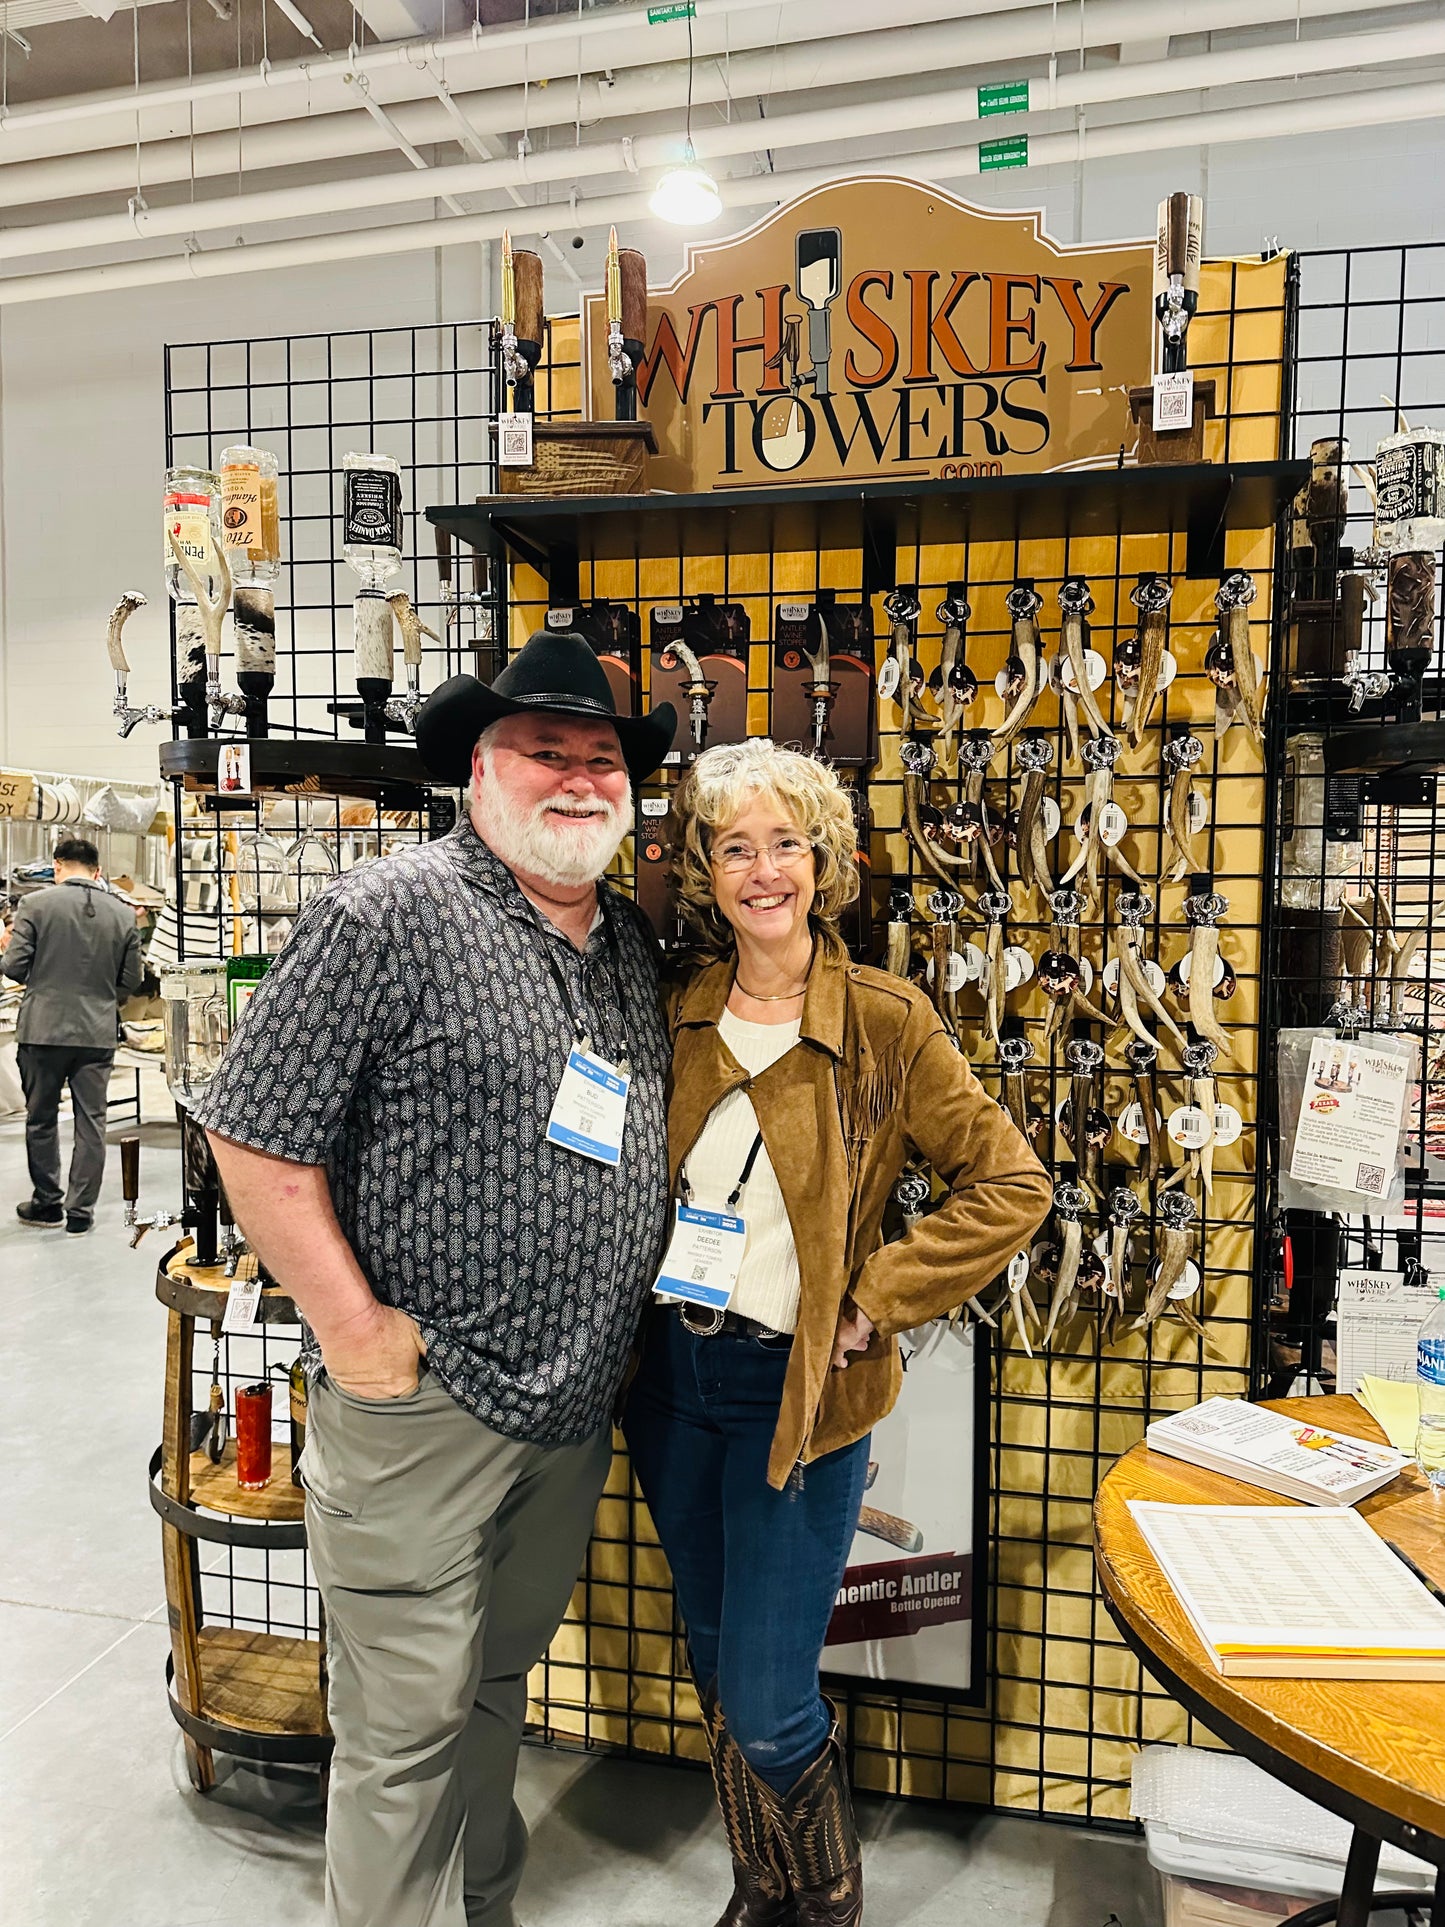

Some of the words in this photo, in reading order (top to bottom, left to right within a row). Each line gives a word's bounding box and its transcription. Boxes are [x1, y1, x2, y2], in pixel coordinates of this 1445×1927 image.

[638, 228, 1130, 407] WHISKEY
[703, 376, 1050, 476] TOWERS
[934, 459, 1004, 480] .com
[348, 520, 375, 539] DANIEL'S
[374, 522, 392, 536] JACK
[782, 606, 808, 614] WHISKEY
[655, 626, 682, 634] ANTLER
[783, 631, 804, 639] WINE
[640, 832, 658, 840] STOP
[1313, 1100, 1334, 1108] TEXAS
[696, 1235, 721, 1247] DEEDEE
[1347, 1279, 1392, 1290] WHISKEY
[1356, 1287, 1386, 1295] TOWERS
[901, 1570, 962, 1597] Antler
[890, 1599, 921, 1613] Bottle
[923, 1594, 961, 1609] Opener
